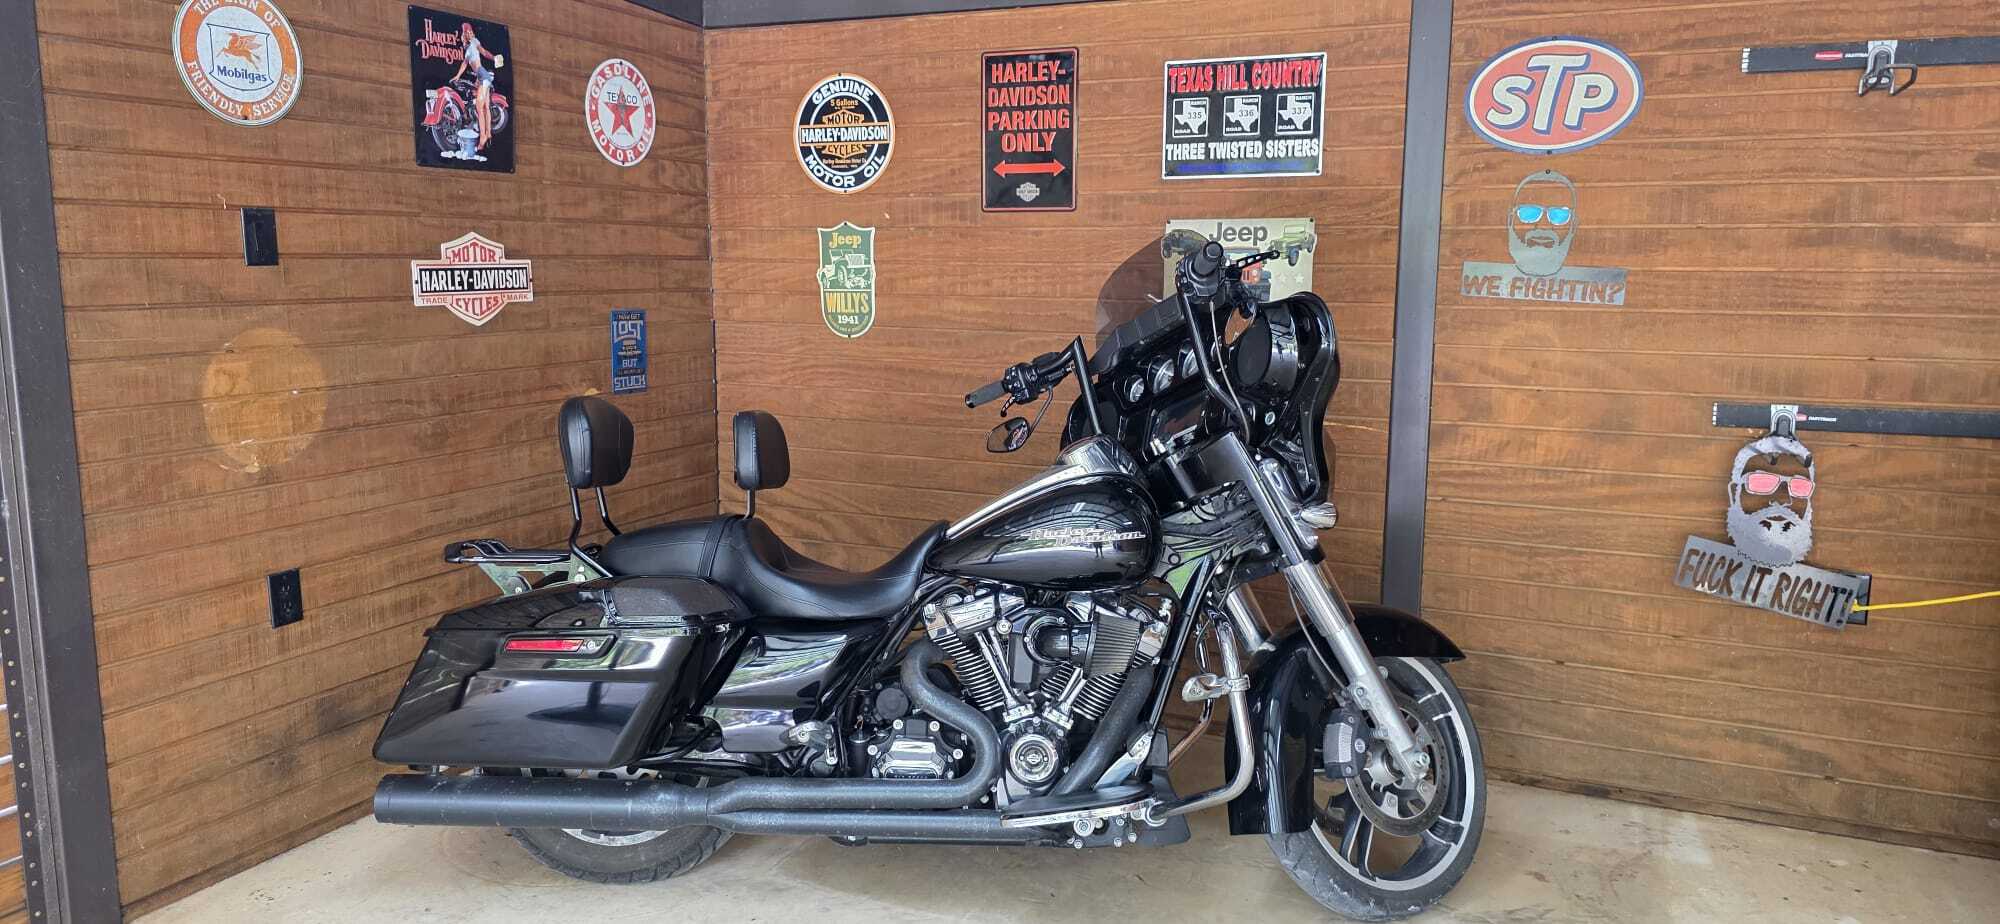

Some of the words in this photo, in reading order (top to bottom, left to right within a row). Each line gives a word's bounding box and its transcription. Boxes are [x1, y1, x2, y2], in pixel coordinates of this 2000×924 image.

[193, 0, 219, 15] THE
[264, 10, 281, 27] OF
[415, 39, 464, 64] DAVIDSON
[216, 65, 267, 84] Mobilgas
[991, 60, 1066, 84] HARLEY-
[1169, 65, 1213, 93] TEXAS
[1216, 63, 1249, 91] HILL
[1251, 58, 1322, 90] COUNTRY
[186, 61, 244, 115] FRIENDLY
[252, 73, 296, 116] SERVICE
[591, 64, 652, 106] GASOLINE
[812, 79, 873, 105] GENUINE
[988, 83, 1071, 107] DAVIDSON
[1486, 52, 1618, 134] STP
[607, 91, 639, 105] TEXACO
[827, 112, 860, 125] MOTOR
[987, 108, 1070, 131] PARKING
[1187, 111, 1202, 119] 335
[1238, 109, 1254, 117] 336
[1291, 107, 1307, 115] 337
[592, 119, 636, 161] MOTOR
[637, 127, 652, 154] OIL
[801, 126, 887, 143] HARLEY-DAVIDSON
[1001, 131, 1056, 153] ONLY
[827, 143, 861, 156] CYCLES
[1166, 142, 1205, 161] THREE
[1208, 140, 1262, 160] TWISTED
[1266, 138, 1319, 159] SISTERS
[805, 154, 856, 187] MOTOR
[863, 155, 885, 178] OIL
[829, 232, 861, 249] Jeep
[1209, 222, 1268, 246] Jeep
[451, 241, 497, 263] MOTOR
[421, 269, 527, 292] HARLEY-DAVIDSON
[1463, 275, 1502, 296] WE
[1509, 277, 1625, 304] FIGHTIN?
[420, 296, 449, 305] TRADE
[506, 293, 529, 301] MARK
[455, 295, 499, 317] CYCLES
[825, 292, 870, 314] WILLYS
[613, 320, 644, 343] LOST
[838, 315, 859, 325] 1941
[622, 358, 638, 368] BUT
[614, 375, 646, 390] STUCK
[1678, 548, 1743, 596] FUCK
[1742, 564, 1773, 603] IT
[1770, 572, 1853, 626] RIGHT!
